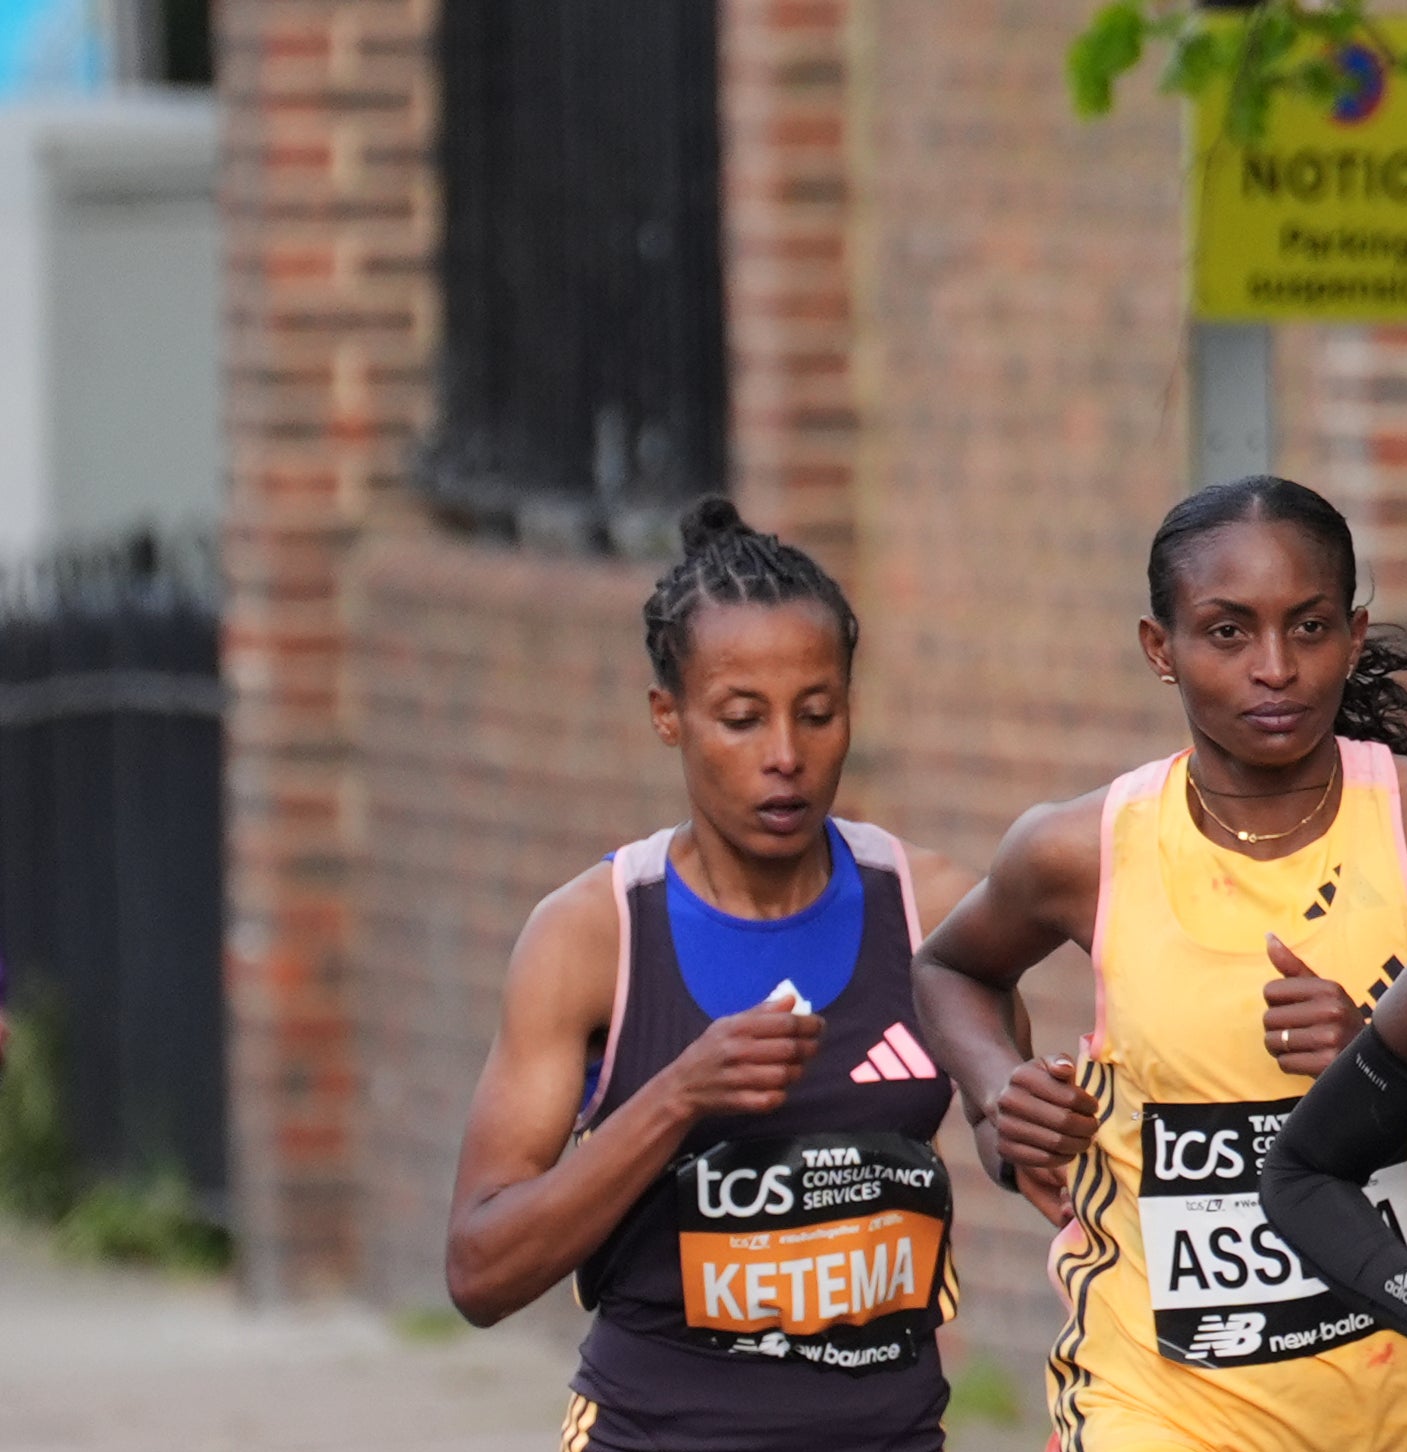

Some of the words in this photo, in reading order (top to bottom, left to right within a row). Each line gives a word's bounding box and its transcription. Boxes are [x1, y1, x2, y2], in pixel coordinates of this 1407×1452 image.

[802, 1147, 862, 1166] TATA
[1154, 1114, 1245, 1180] tcs
[697, 1158, 794, 1218] tcs
[803, 1164, 934, 1189] CONSULTANCY
[803, 1181, 881, 1211] SERVICES
[703, 1237, 914, 1322] KETEMA
[1269, 1330, 1318, 1353] new
[1320, 1313, 1375, 1342] bala
